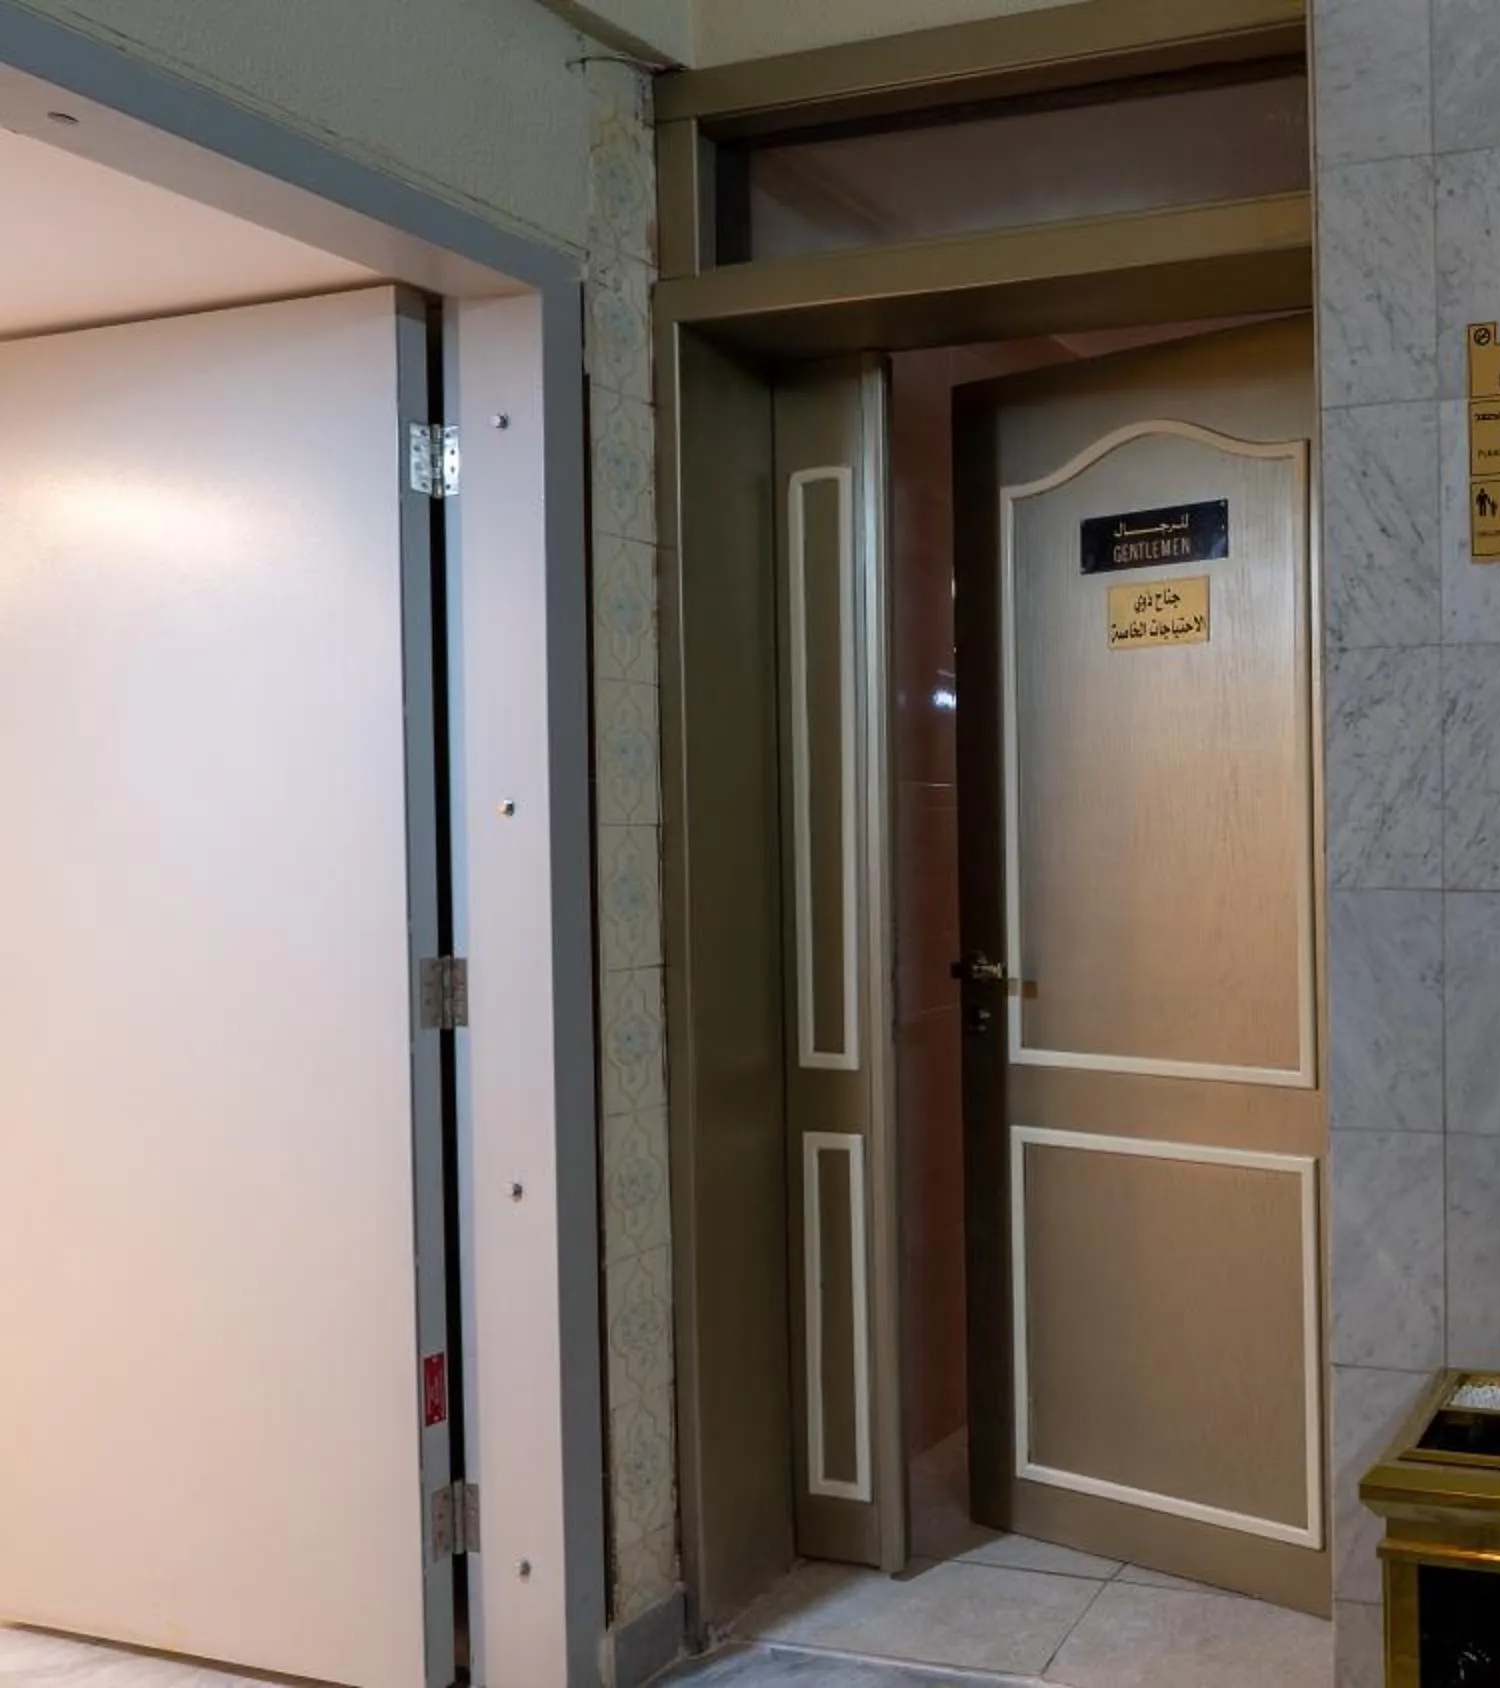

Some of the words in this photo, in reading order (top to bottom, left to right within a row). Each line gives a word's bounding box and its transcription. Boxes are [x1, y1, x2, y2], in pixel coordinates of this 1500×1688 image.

[1112, 537, 1191, 564] GENTLEMEN
[1133, 591, 1153, 615] ذوي
[1154, 587, 1181, 612] جناح
[1111, 619, 1147, 643] الخاصة
[1149, 614, 1204, 640] الاحتياجات
